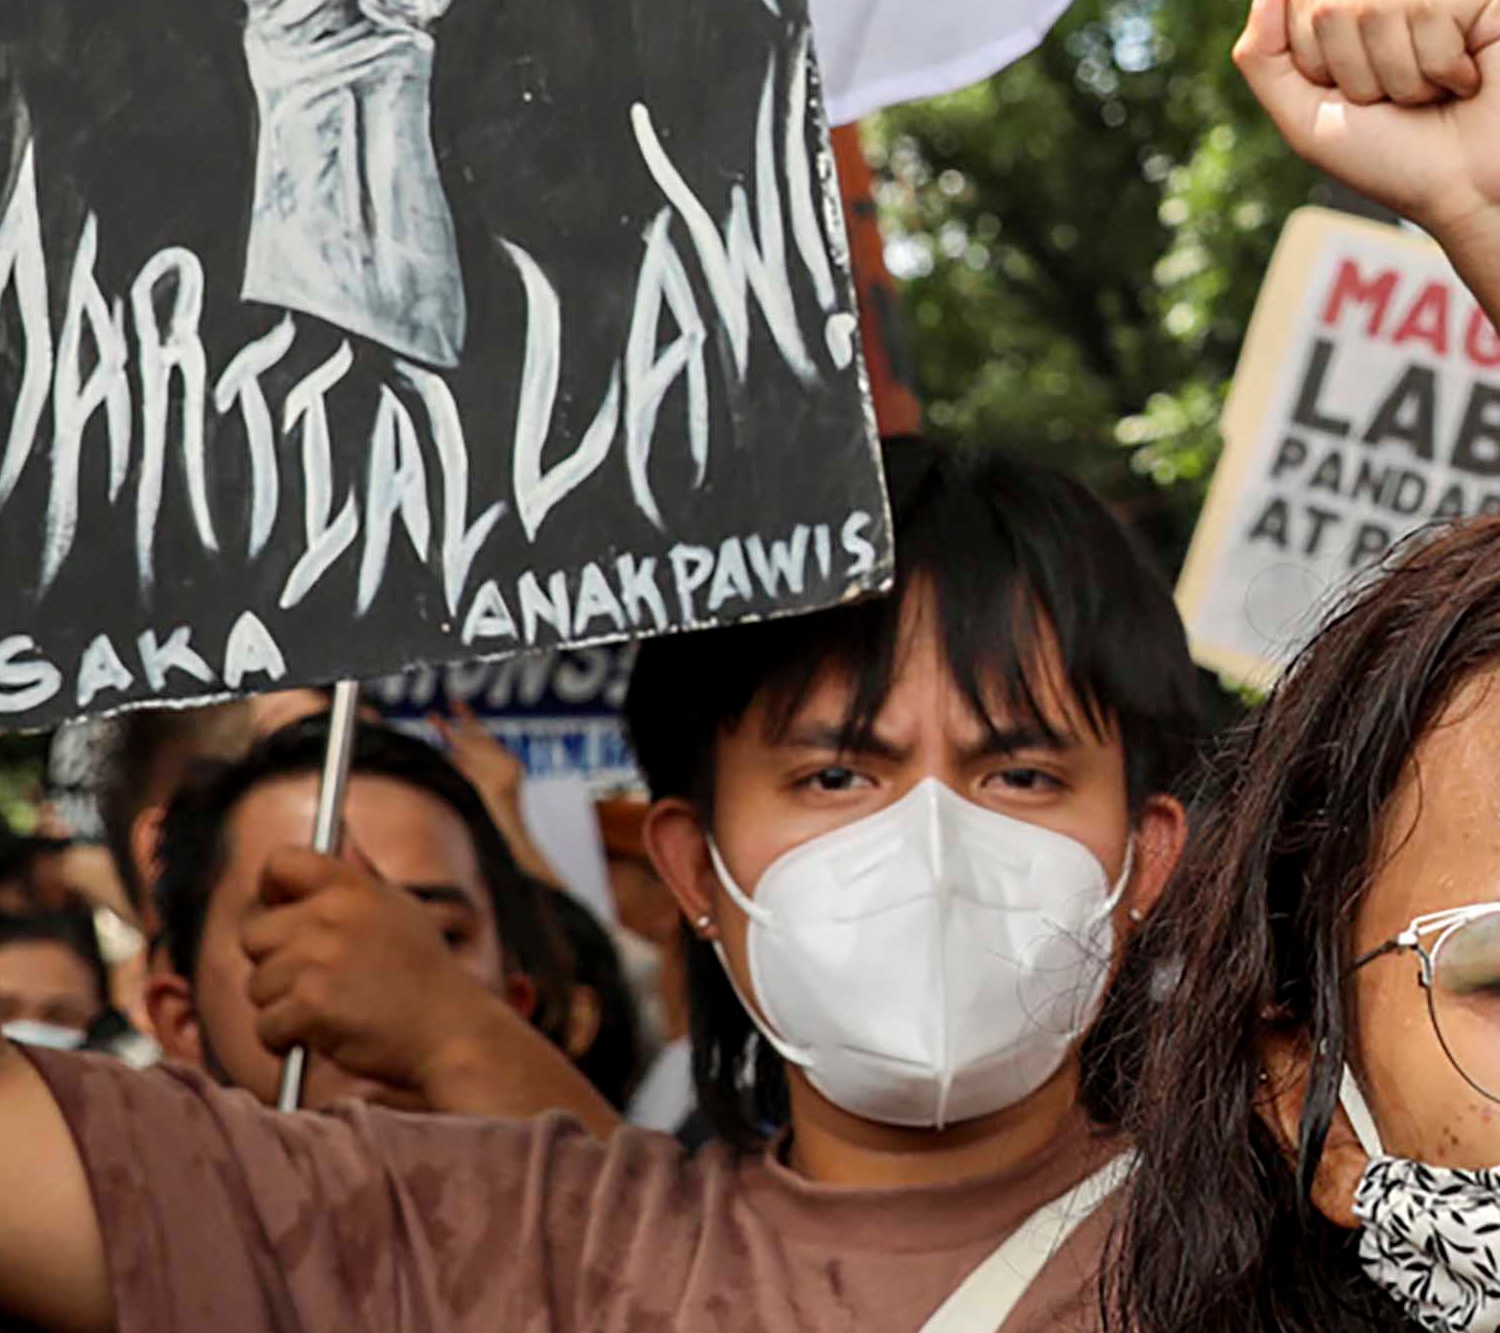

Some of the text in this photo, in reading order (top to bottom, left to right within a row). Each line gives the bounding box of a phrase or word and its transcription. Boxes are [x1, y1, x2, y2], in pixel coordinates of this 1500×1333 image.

[497, 25, 857, 542] LAW!
[462, 511, 876, 646] ANAKPAWIS
[1248, 497, 1340, 556] AT
